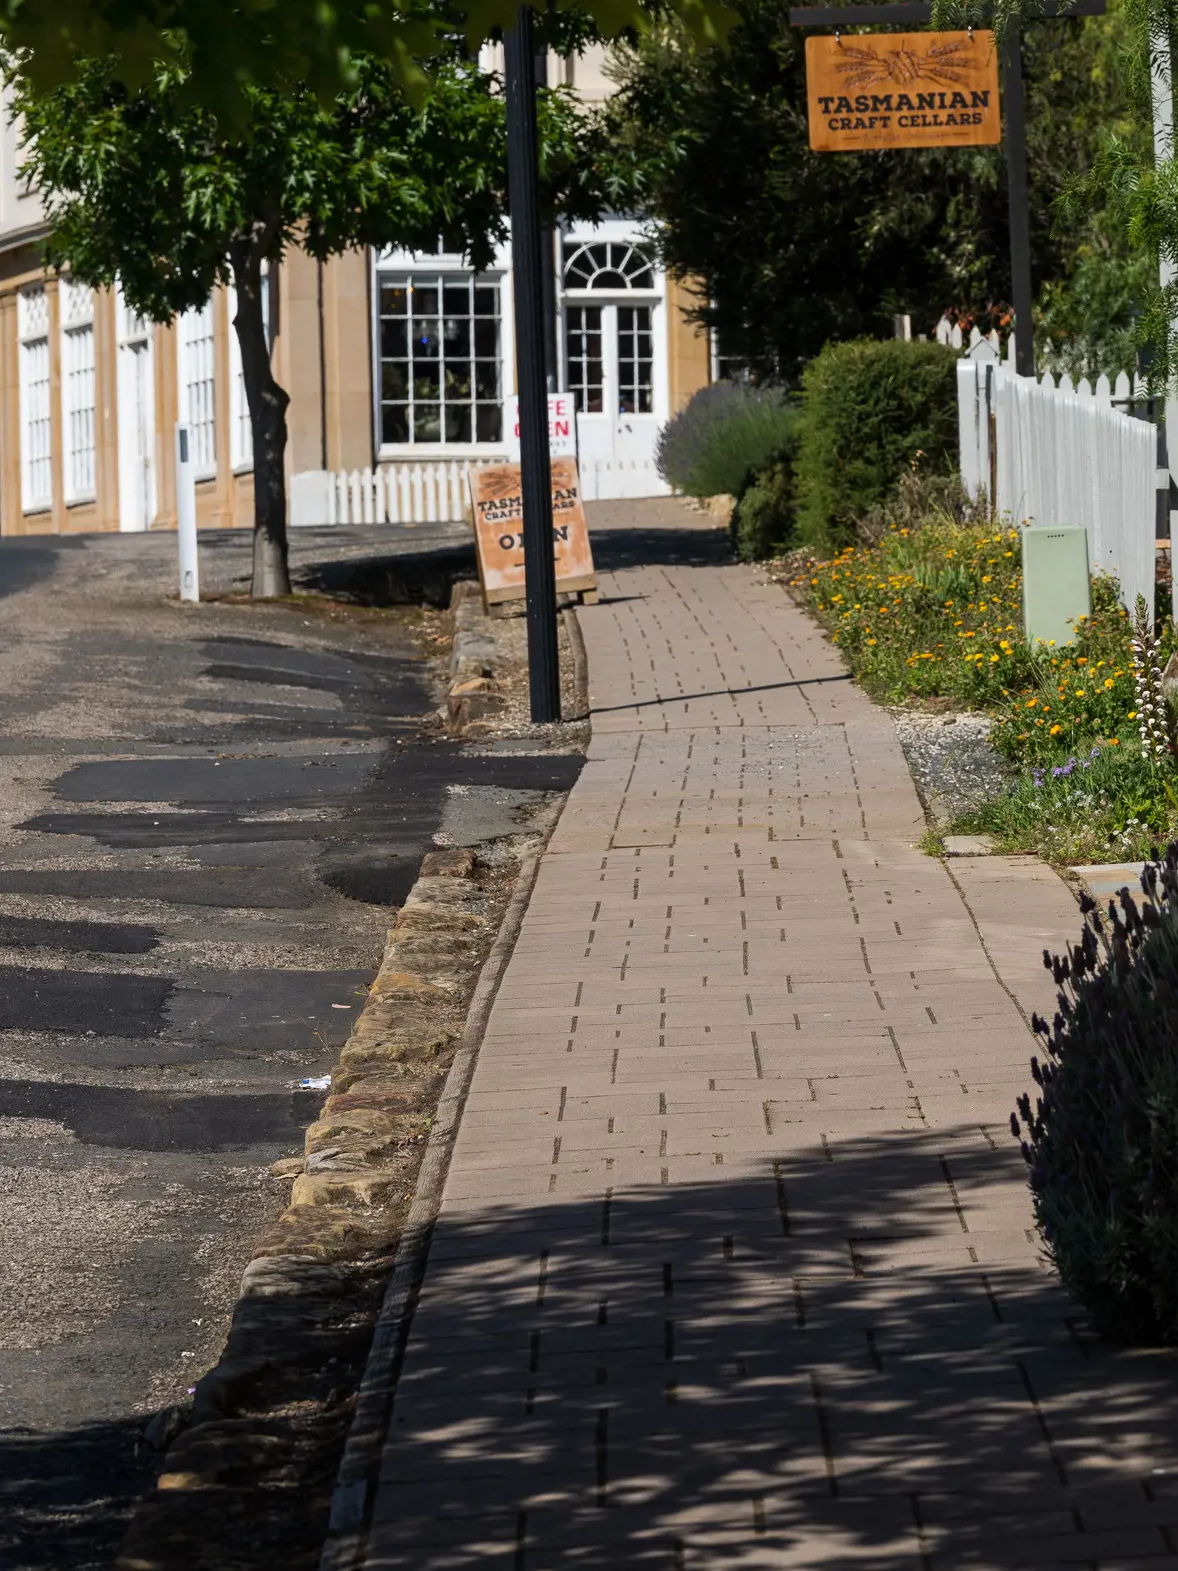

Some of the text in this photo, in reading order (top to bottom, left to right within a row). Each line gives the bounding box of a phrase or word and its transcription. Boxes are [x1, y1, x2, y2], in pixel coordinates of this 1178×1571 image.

[818, 90, 990, 114] TASMANIAN
[828, 113, 982, 131] CRAFT CELLARS
[477, 487, 577, 512] TASMAN
[499, 526, 568, 550] ON
